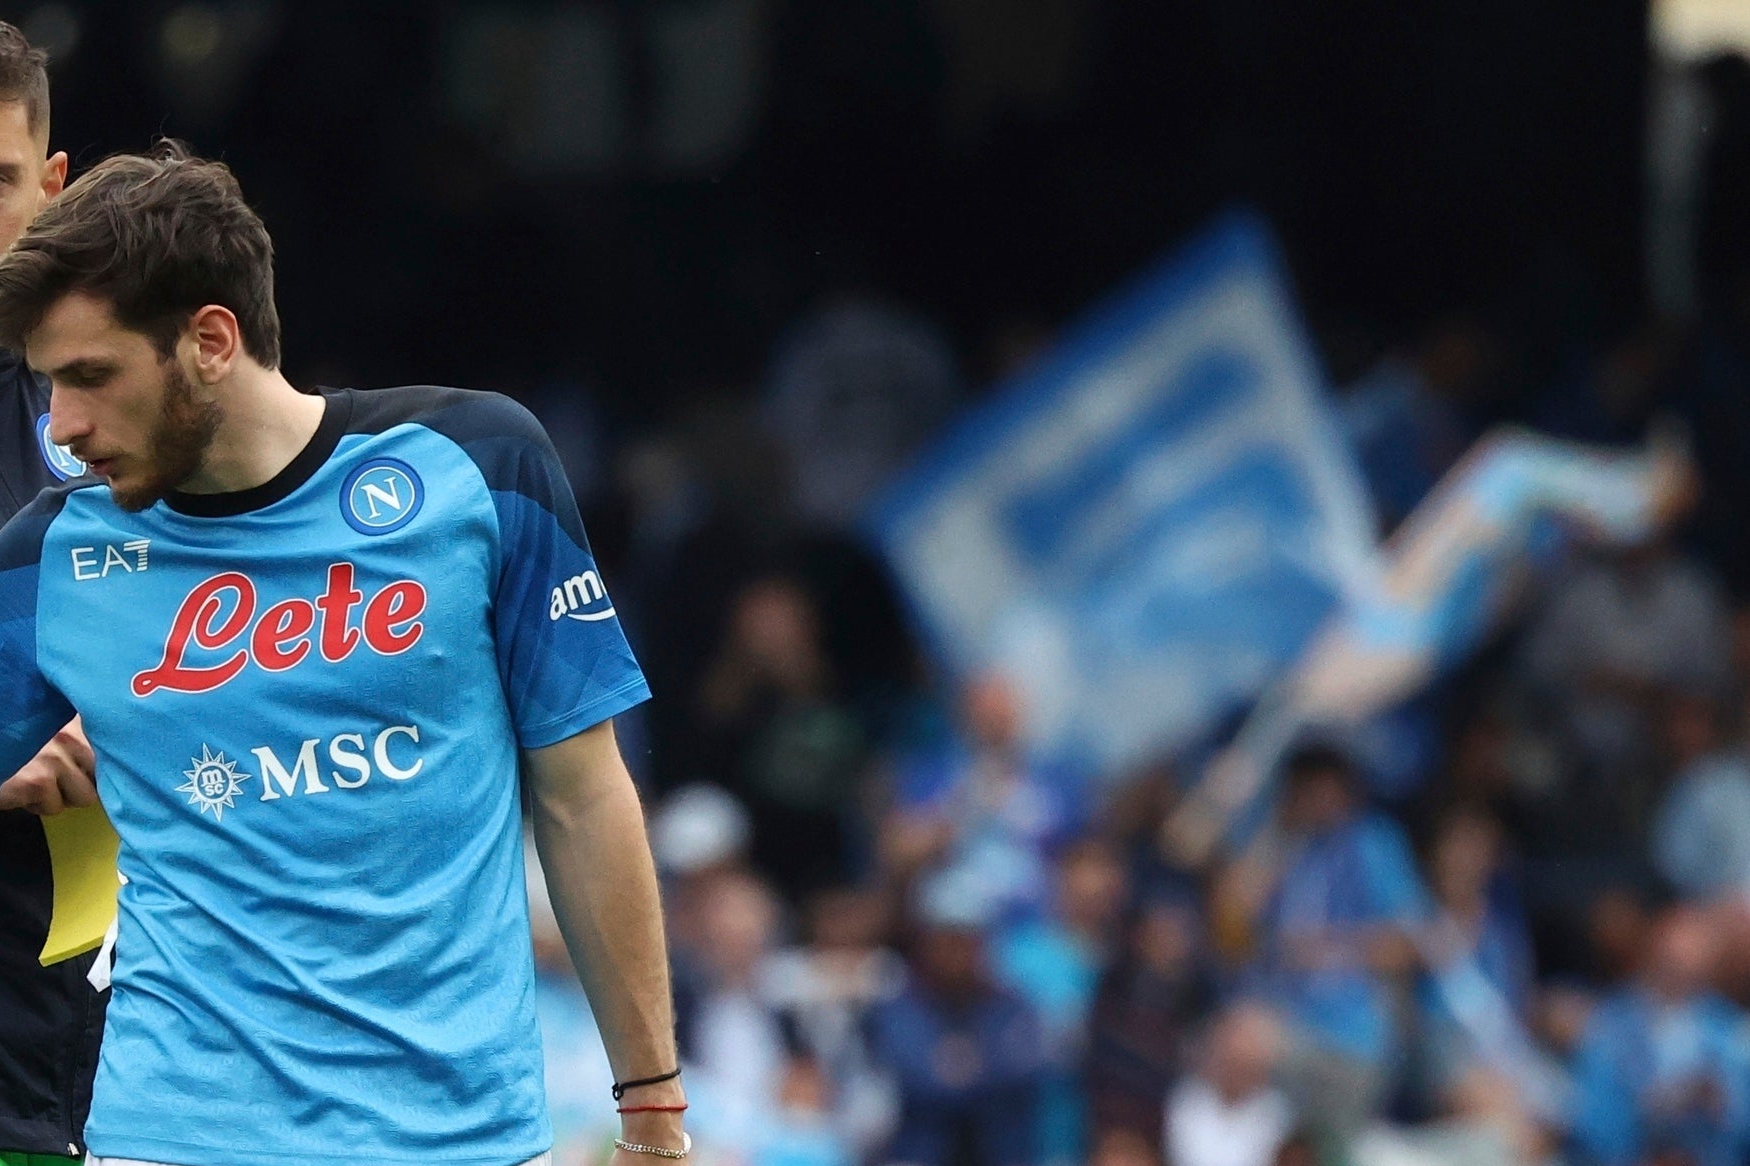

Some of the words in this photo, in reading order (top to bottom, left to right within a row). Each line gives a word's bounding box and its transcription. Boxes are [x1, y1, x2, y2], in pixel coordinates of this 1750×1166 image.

[361, 476, 402, 520] N
[71, 540, 151, 580] EA7
[550, 570, 607, 620] am
[131, 563, 427, 697] Lete
[251, 725, 424, 802] MSC
